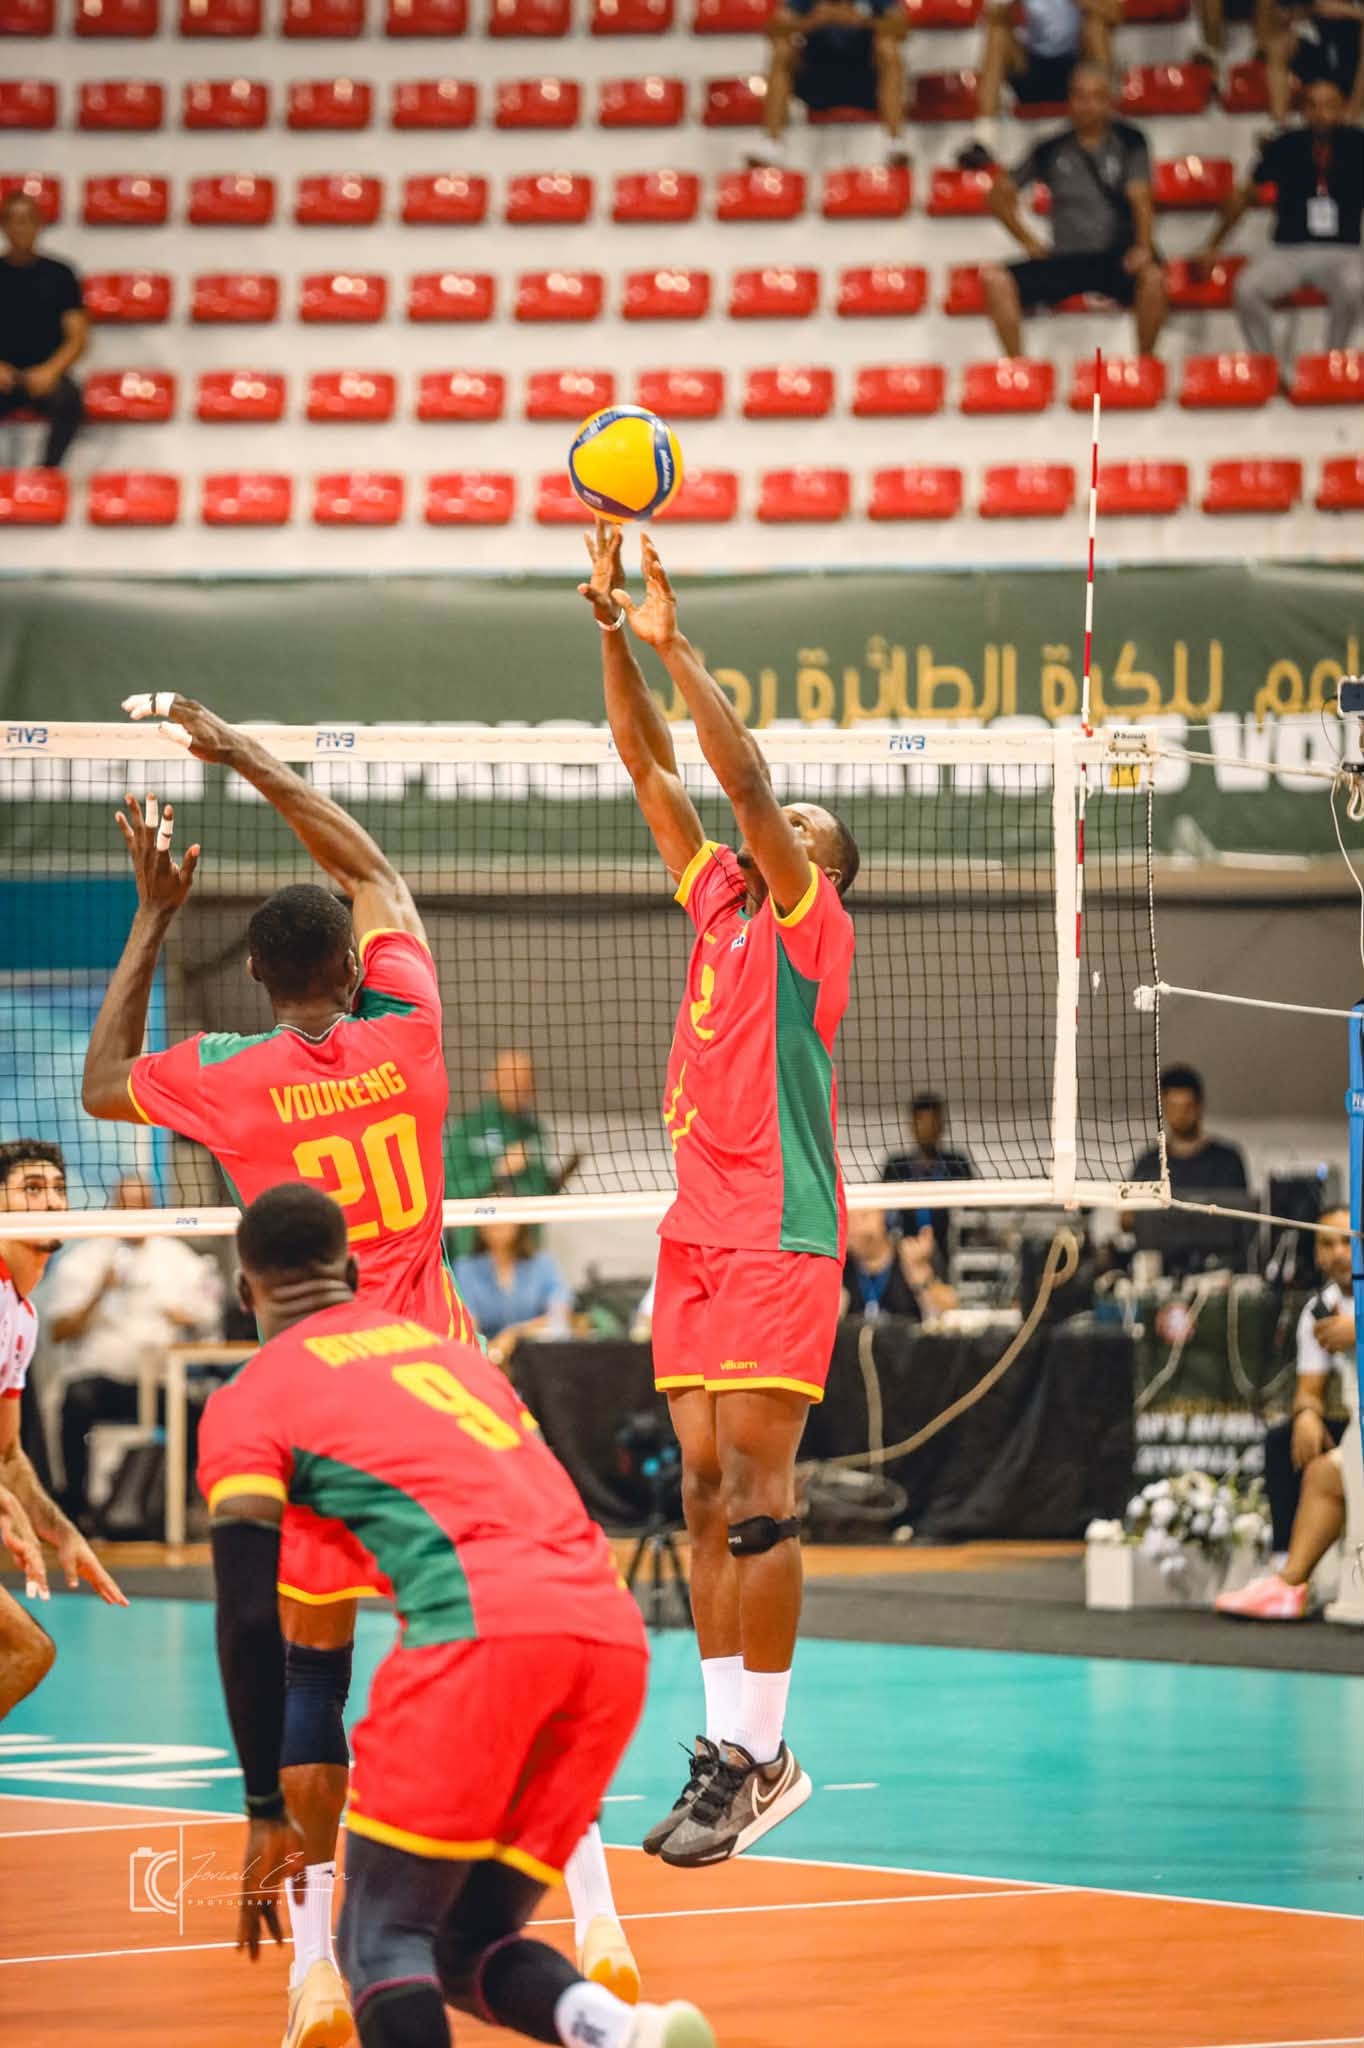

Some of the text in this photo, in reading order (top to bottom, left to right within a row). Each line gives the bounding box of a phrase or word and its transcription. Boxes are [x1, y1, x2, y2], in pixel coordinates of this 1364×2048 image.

[6, 727, 49, 744] FIVB
[315, 731, 356, 749] FIVB
[889, 735, 926, 751] FIVB
[269, 1061, 407, 1124] VOUKENG
[292, 1113, 428, 1242] 20
